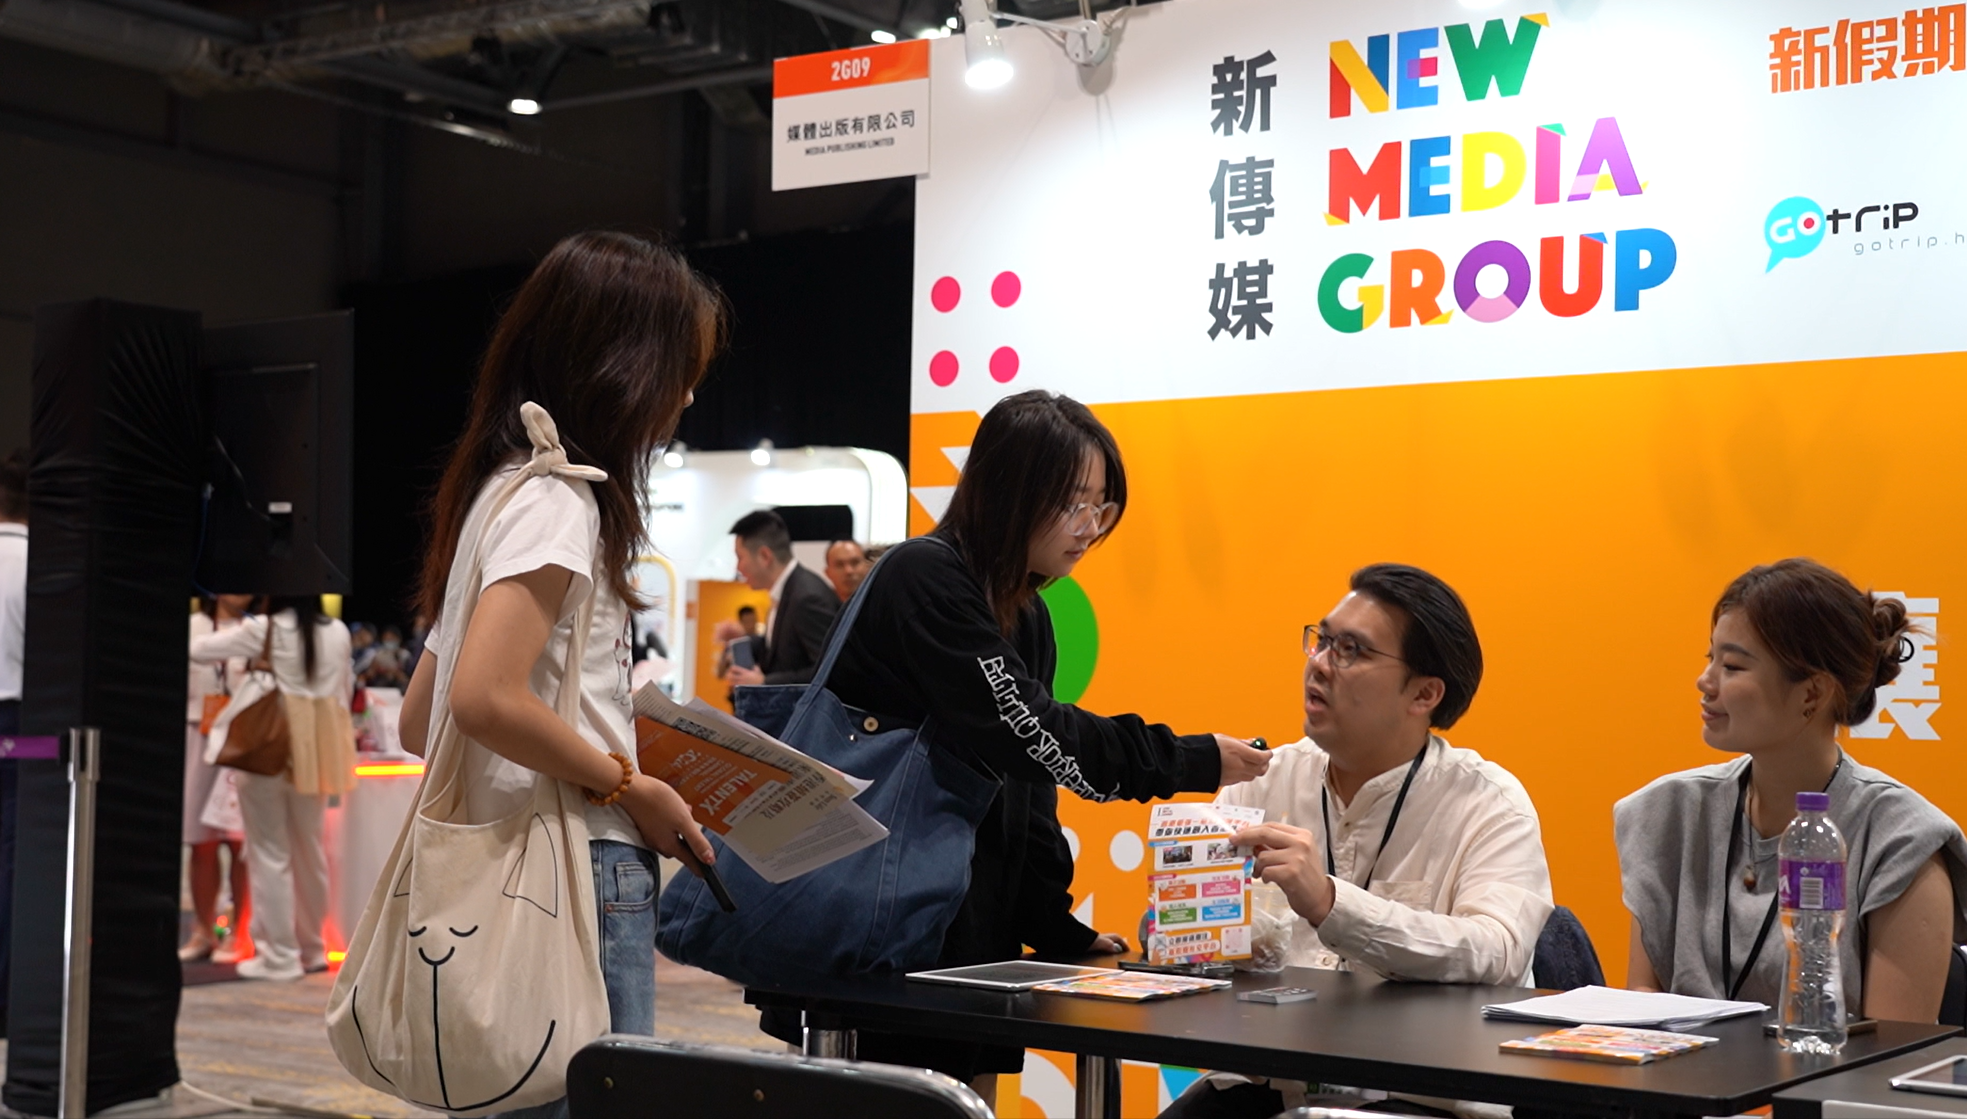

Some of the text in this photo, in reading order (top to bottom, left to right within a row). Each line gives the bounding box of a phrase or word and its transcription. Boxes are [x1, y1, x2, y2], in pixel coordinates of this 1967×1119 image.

[831, 57, 871, 81] 2G09
[1329, 12, 1550, 119] NEW
[1769, 3, 1966, 94] 新假期
[787, 110, 916, 143] 媒體出版有限公司
[804, 137, 895, 156] MEDIA PUBLISHING LIMITED
[1323, 116, 1649, 226] MEDIA
[1207, 49, 1278, 341] 新傳媒
[1317, 227, 1677, 334] GROUP
